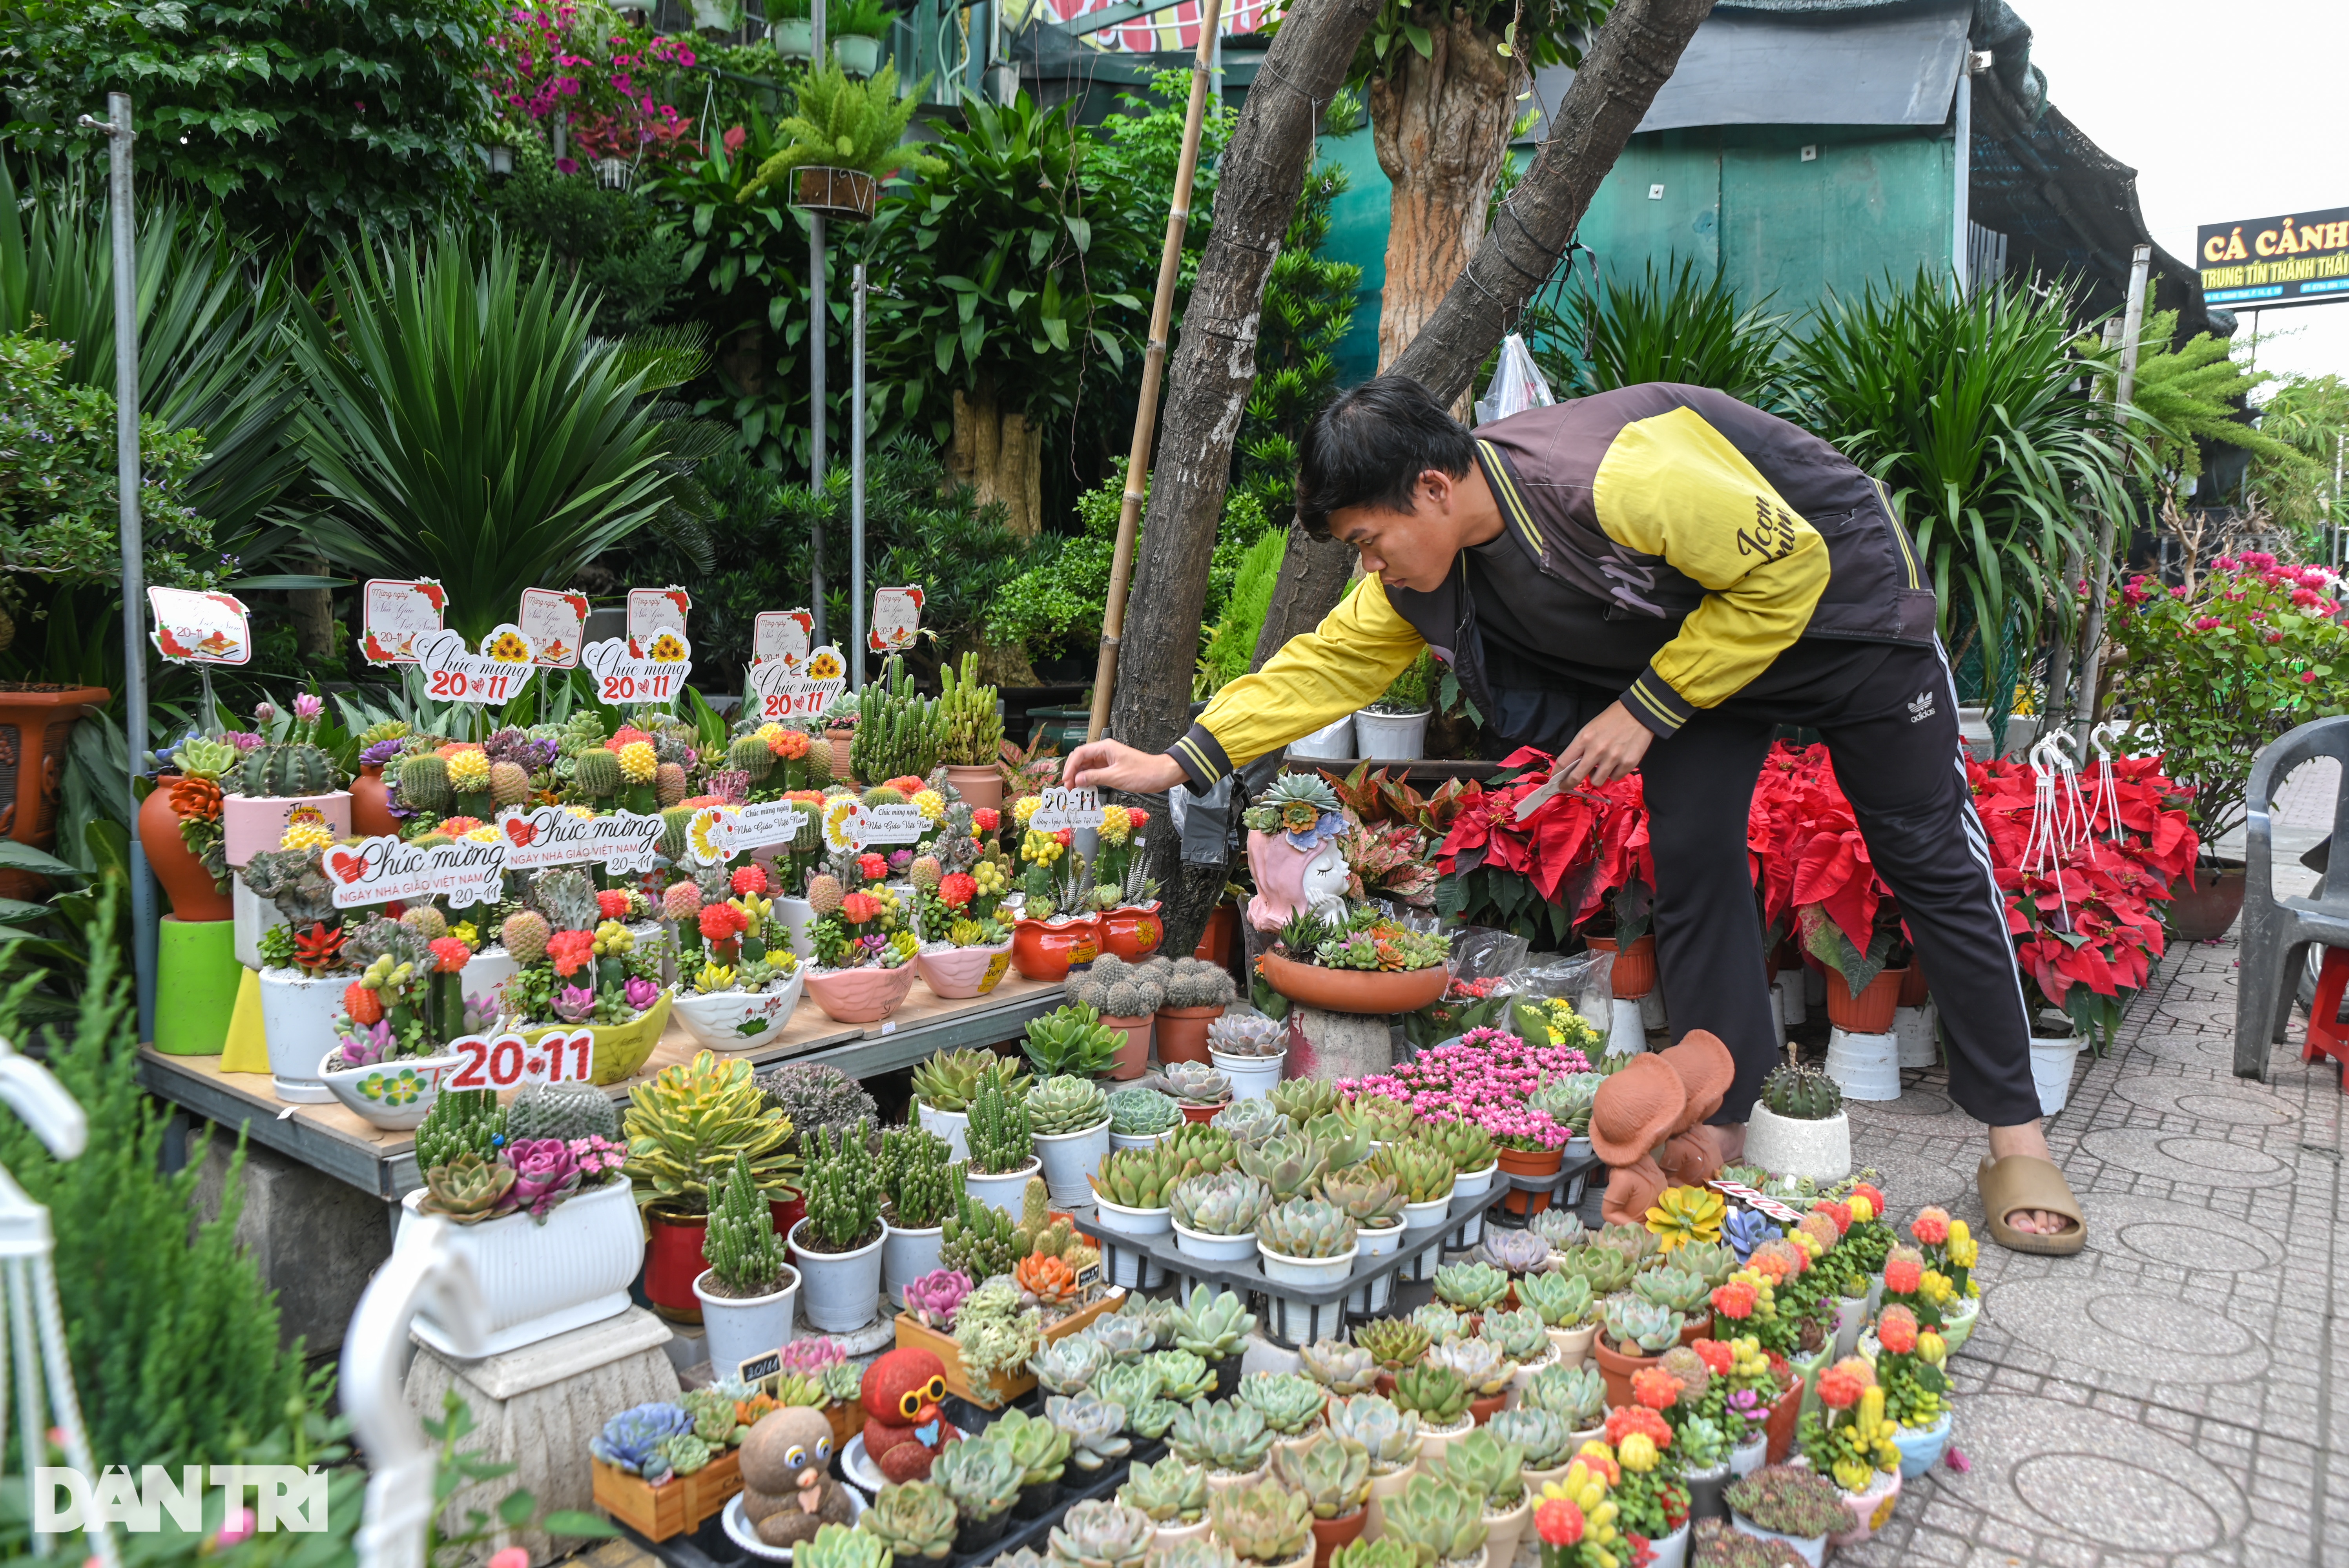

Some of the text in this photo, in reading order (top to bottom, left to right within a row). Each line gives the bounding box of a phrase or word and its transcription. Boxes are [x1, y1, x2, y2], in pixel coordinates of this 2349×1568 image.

[2204, 217, 2349, 262] CÁ CẢNH
[2201, 266, 2244, 289] TRUNG
[2245, 260, 2268, 285] TÍN
[2317, 251, 2349, 277] THÁI
[1737, 496, 1773, 559] Icon
[372, 589, 409, 600] Mừng ngày
[527, 596, 557, 609] Mừng ngày
[633, 597, 660, 607] Mừng ngày
[372, 600, 414, 620] Nhà Giáo
[177, 627, 202, 638] 20-11
[394, 616, 436, 630] Việt Nam
[761, 620, 775, 628] Mừng
[381, 632, 402, 642] 20-11
[417, 636, 475, 673] Chúc
[587, 644, 640, 677] Chúc
[764, 653, 779, 662] 20-11
[430, 670, 508, 699] 20 11
[604, 675, 669, 699] 20 11
[754, 665, 798, 696] Chúc
[765, 692, 823, 716] 20 11
[1911, 707, 1935, 723] adidas
[746, 804, 789, 817] Chúc mừng ngày
[1042, 791, 1097, 813] 20-11
[892, 808, 905, 817] mừng
[906, 808, 917, 817] ngày
[528, 811, 662, 853] Chúc mừng
[734, 815, 807, 835] Nhà Giáo Việt Nam
[866, 820, 932, 831] Nhà Giáo Việt Nam
[357, 841, 505, 883] Chúc mừng
[511, 844, 638, 865] NGÀY NHÀ GIÁO VIỆT NAM
[611, 854, 651, 871] 20-11
[340, 872, 483, 903] NGÀY NHÀ GIÁO VIỆT NAM
[455, 883, 500, 903] 20-11
[746, 1357, 778, 1381] 20/11
